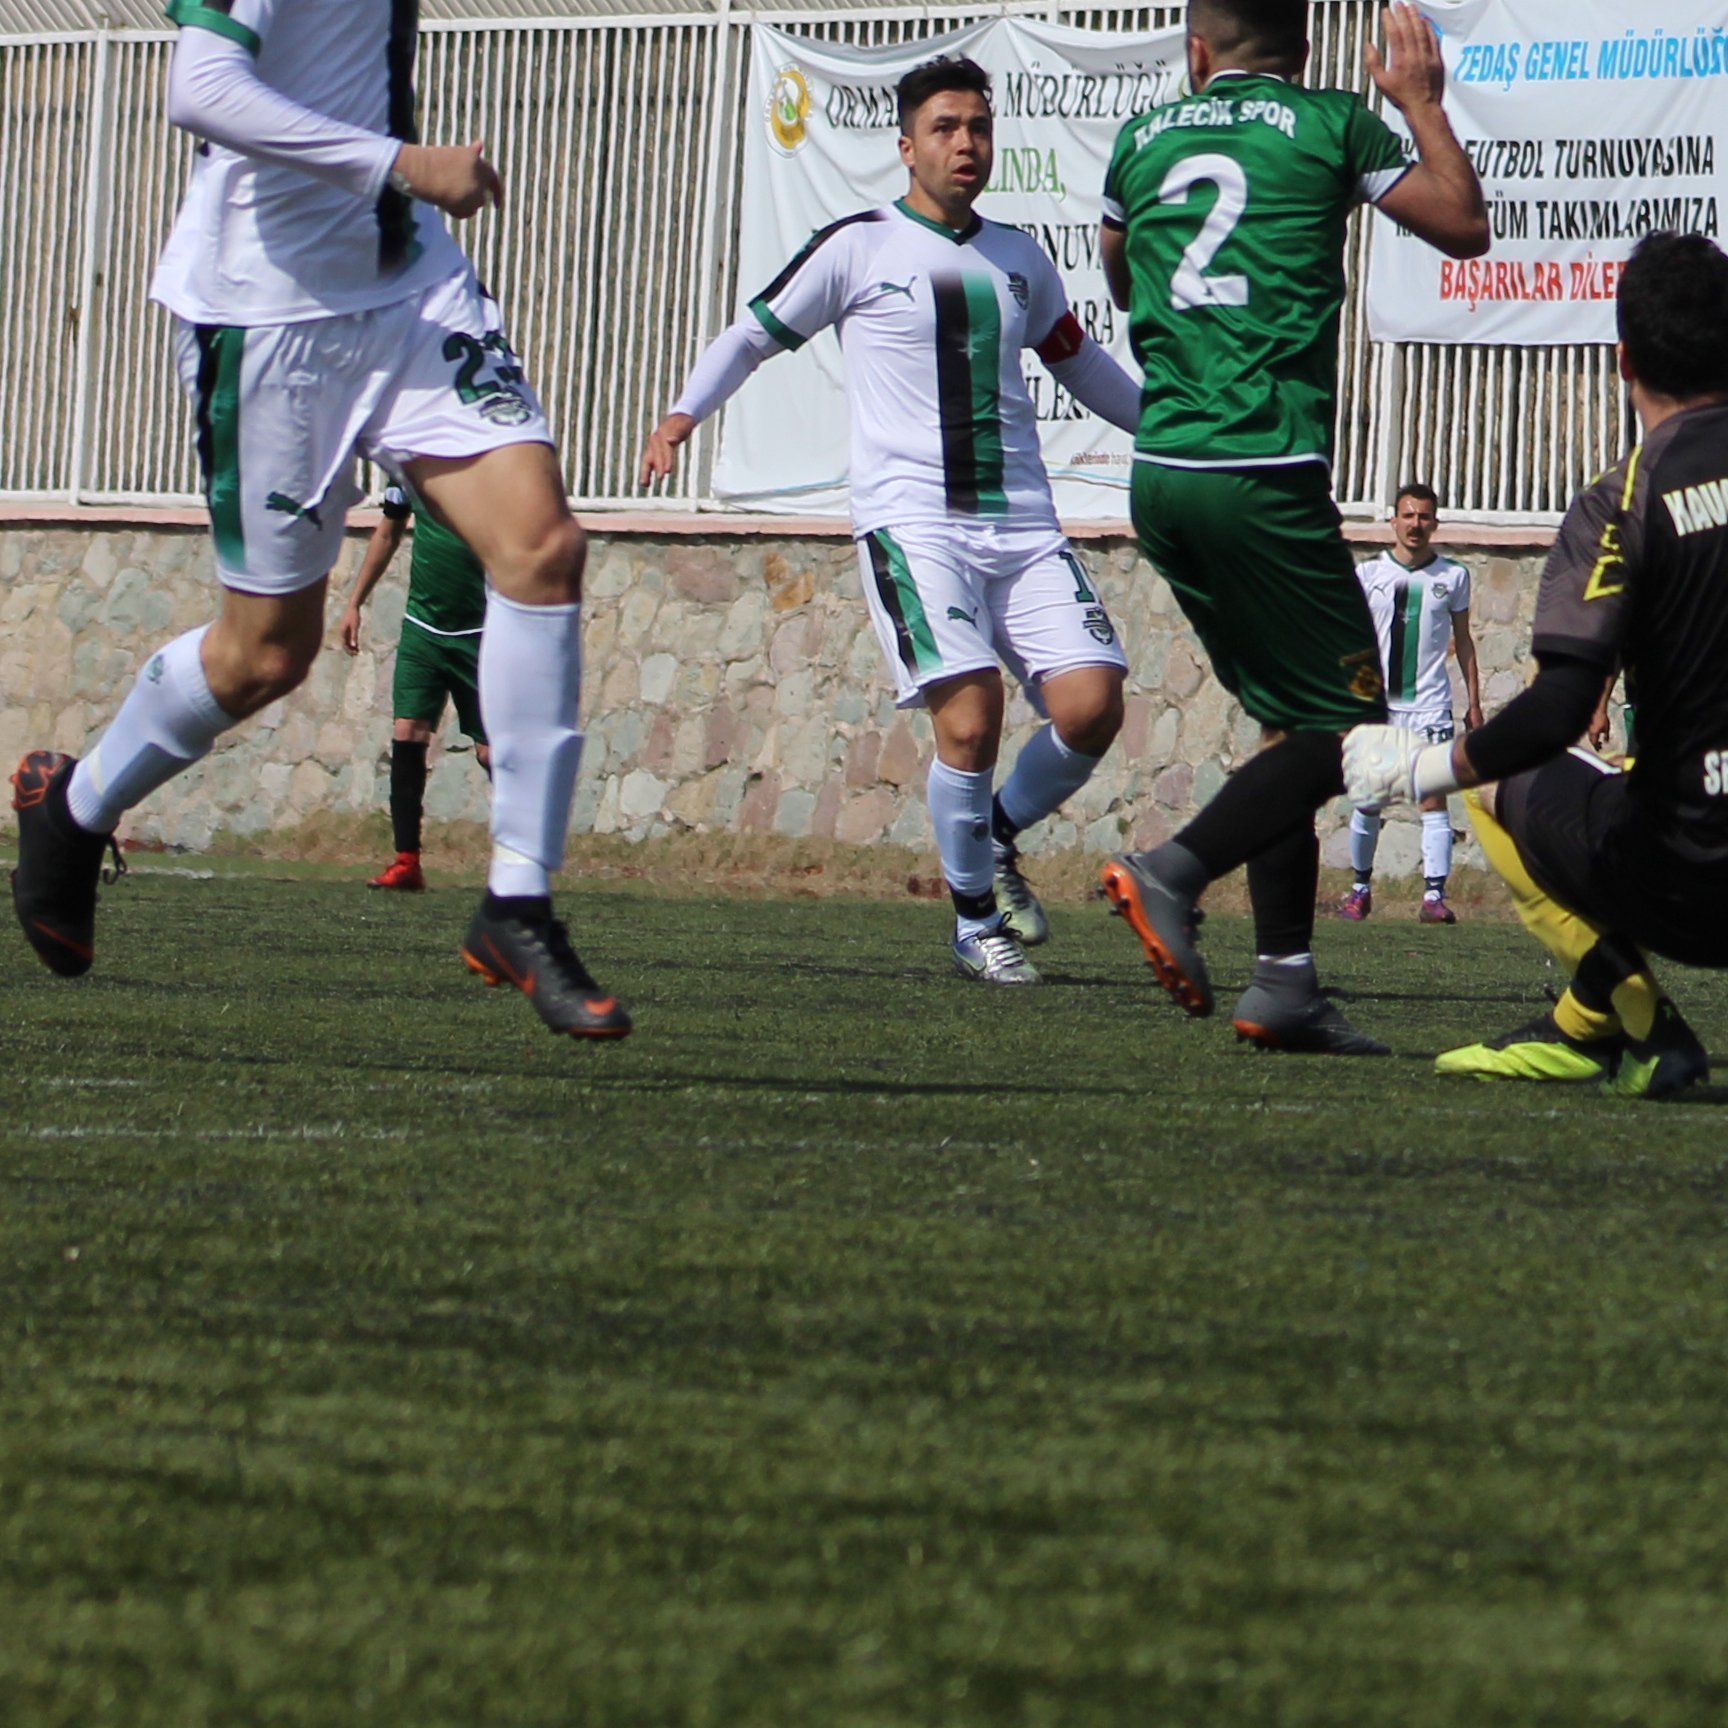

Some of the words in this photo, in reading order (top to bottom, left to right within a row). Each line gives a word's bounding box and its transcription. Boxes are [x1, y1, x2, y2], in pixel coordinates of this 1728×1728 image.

[1525, 41, 1589, 81] GENEL
[826, 84, 900, 129] ORMA
[1133, 96, 1233, 152] KALECİK
[1237, 99, 1297, 139] SPOR
[1465, 139, 1544, 179] FUTBOL
[1158, 153, 1248, 311] 2
[1440, 258, 1563, 313] BAŞARILAR
[1569, 251, 1628, 301] DİLE
